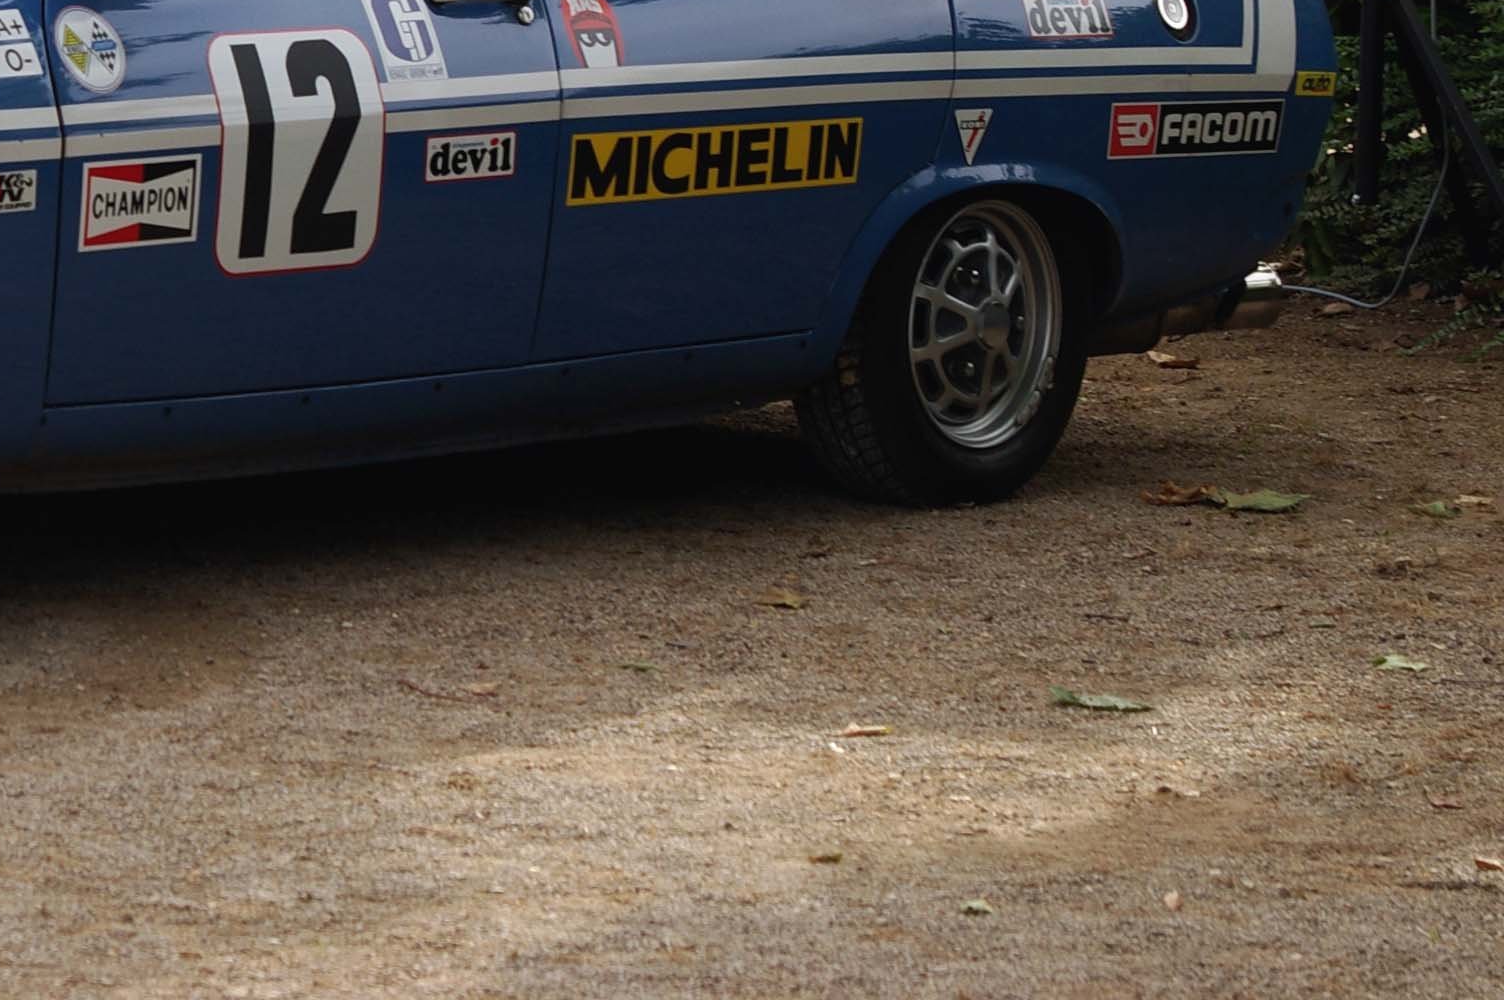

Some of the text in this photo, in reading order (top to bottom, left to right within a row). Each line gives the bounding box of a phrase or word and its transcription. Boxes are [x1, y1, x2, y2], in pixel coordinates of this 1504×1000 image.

[1161, 109, 1278, 146] FACOM
[229, 38, 362, 260] 12
[430, 137, 512, 177] devil
[569, 121, 861, 202] MICHELIN
[92, 186, 189, 220] CHAMPION
